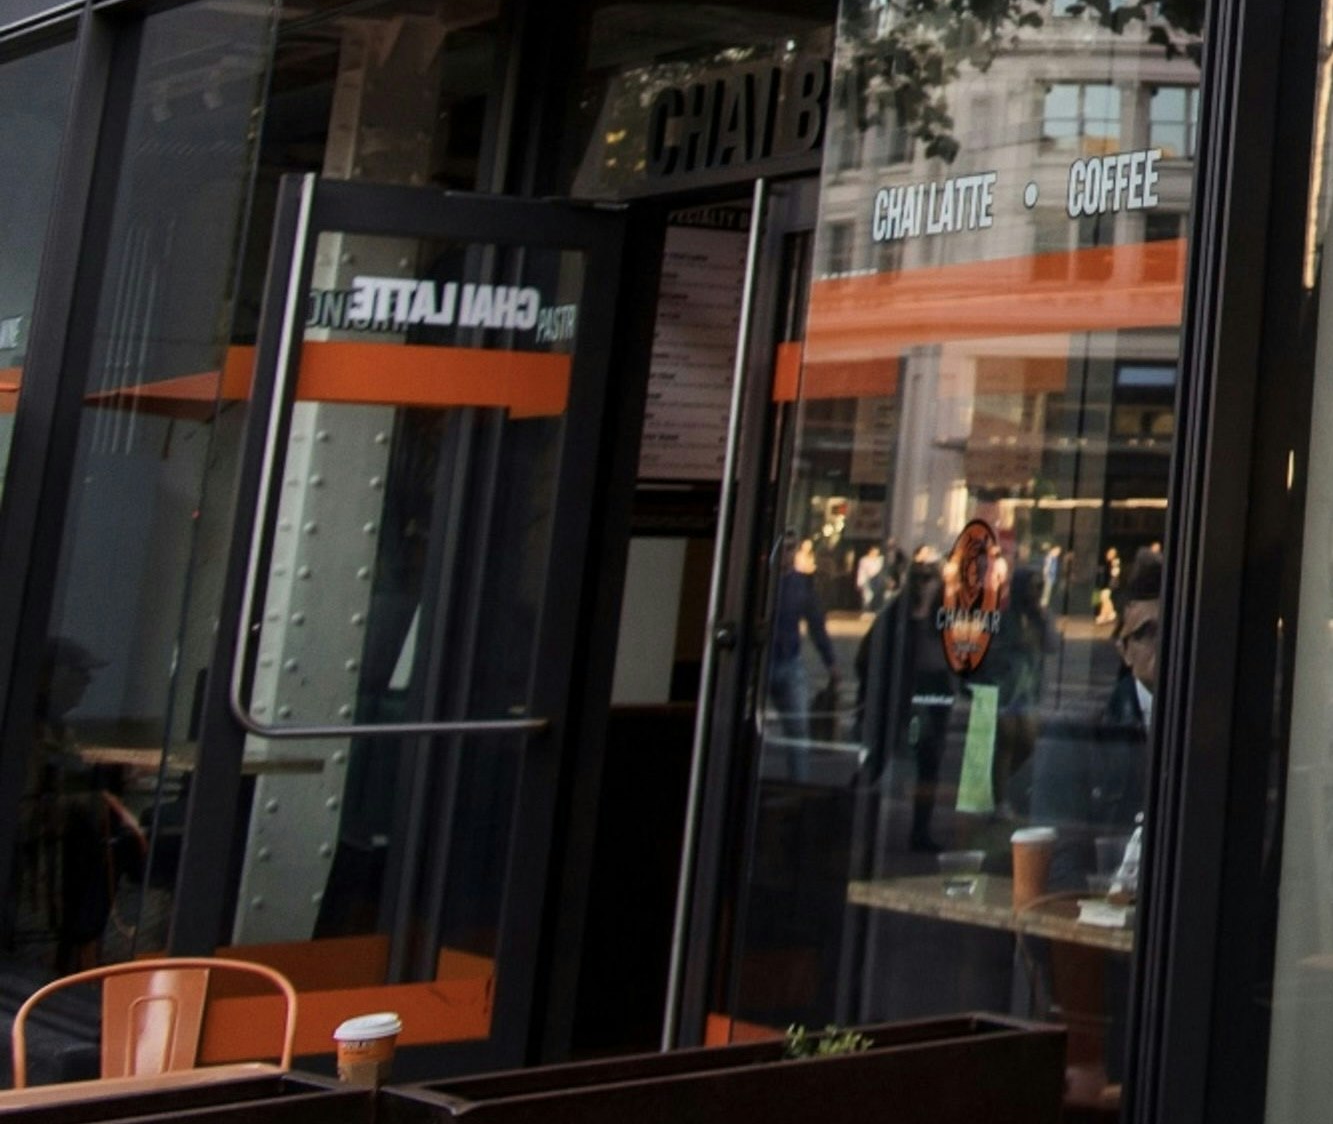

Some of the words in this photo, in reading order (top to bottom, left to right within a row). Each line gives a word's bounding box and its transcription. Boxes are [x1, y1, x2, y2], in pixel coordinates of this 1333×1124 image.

[647, 66, 781, 176] CHAI
[871, 183, 924, 243] CHAI
[925, 170, 998, 236] LATTE
[1067, 148, 1163, 218] COFFEE
